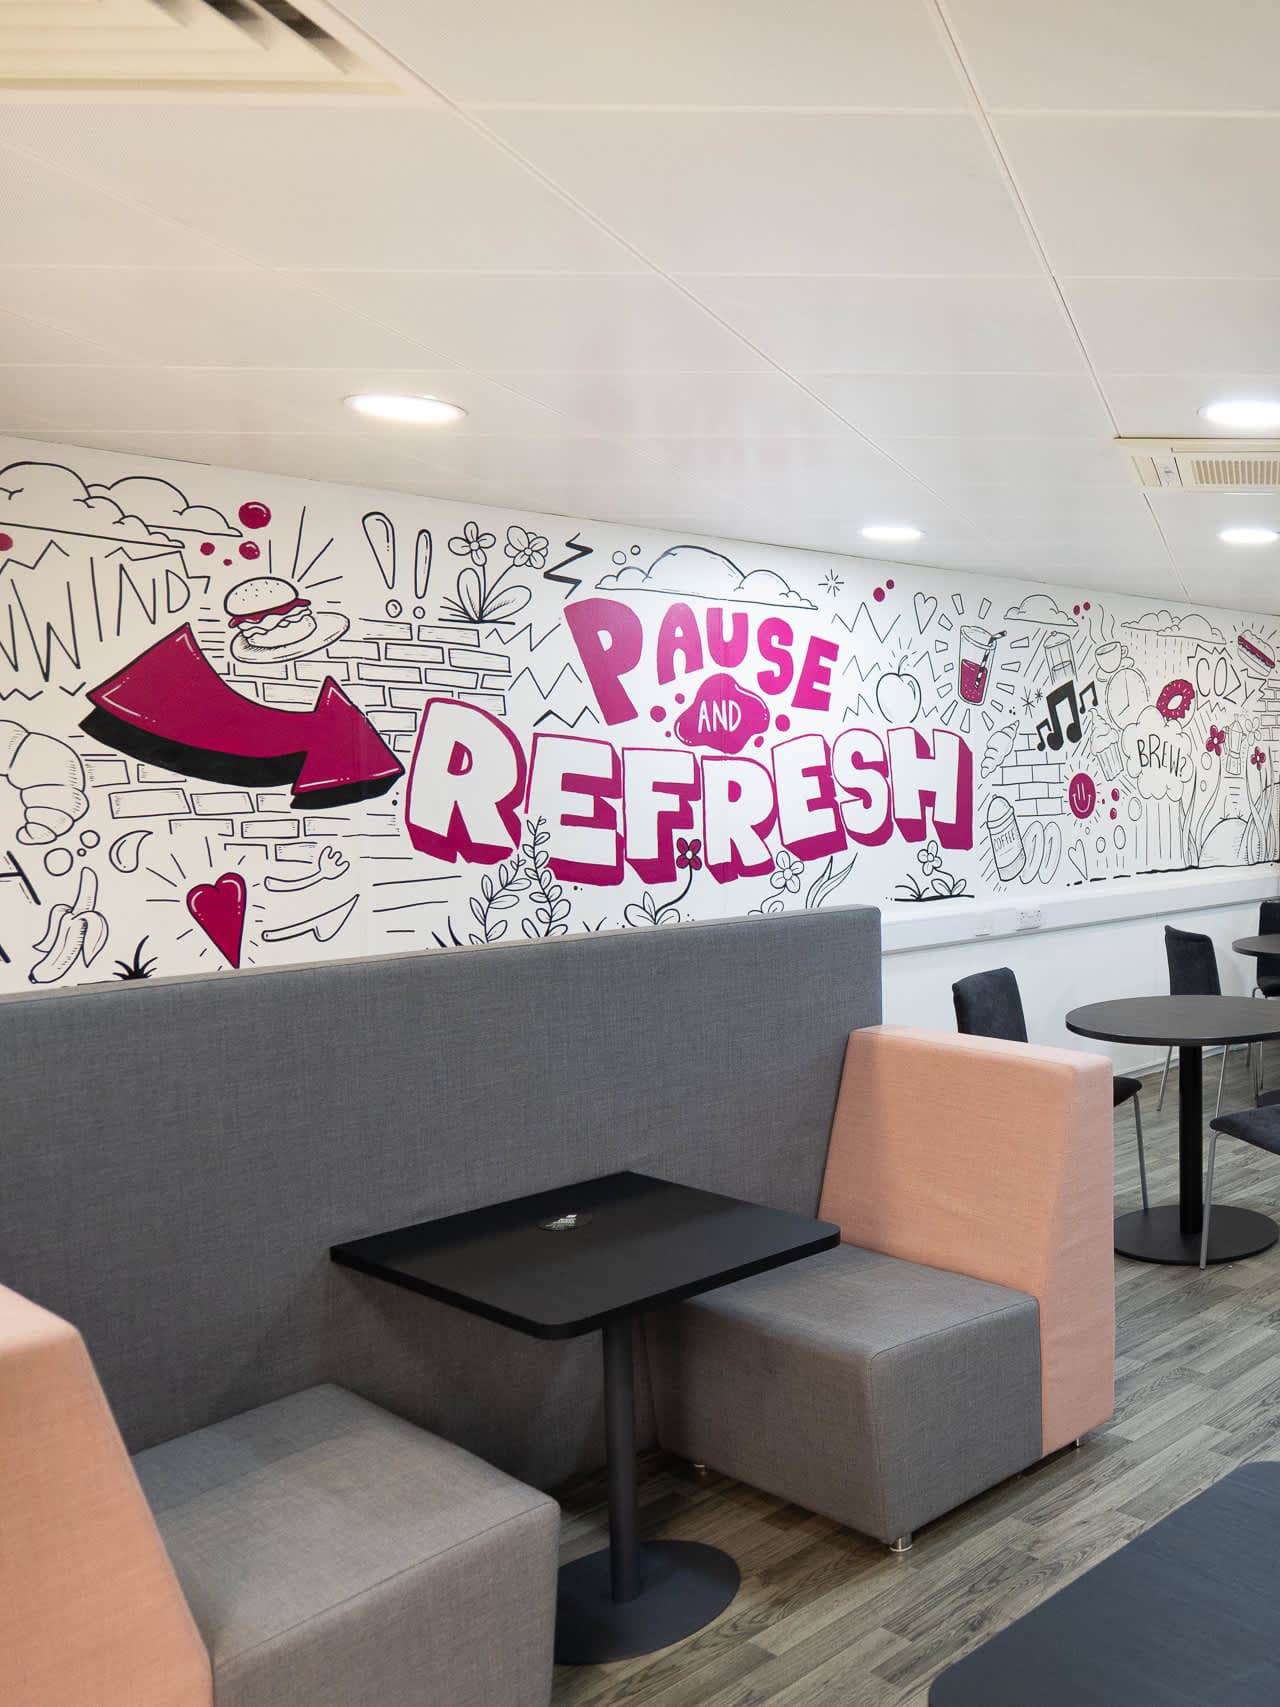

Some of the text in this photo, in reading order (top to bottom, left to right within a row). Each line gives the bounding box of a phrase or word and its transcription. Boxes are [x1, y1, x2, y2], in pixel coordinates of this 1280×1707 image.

[564, 597, 839, 725] PAUSE
[1196, 656, 1256, 708] COZY
[696, 698, 742, 734] AND
[1136, 733, 1187, 778] BREW?
[404, 696, 974, 887] REFRESH
